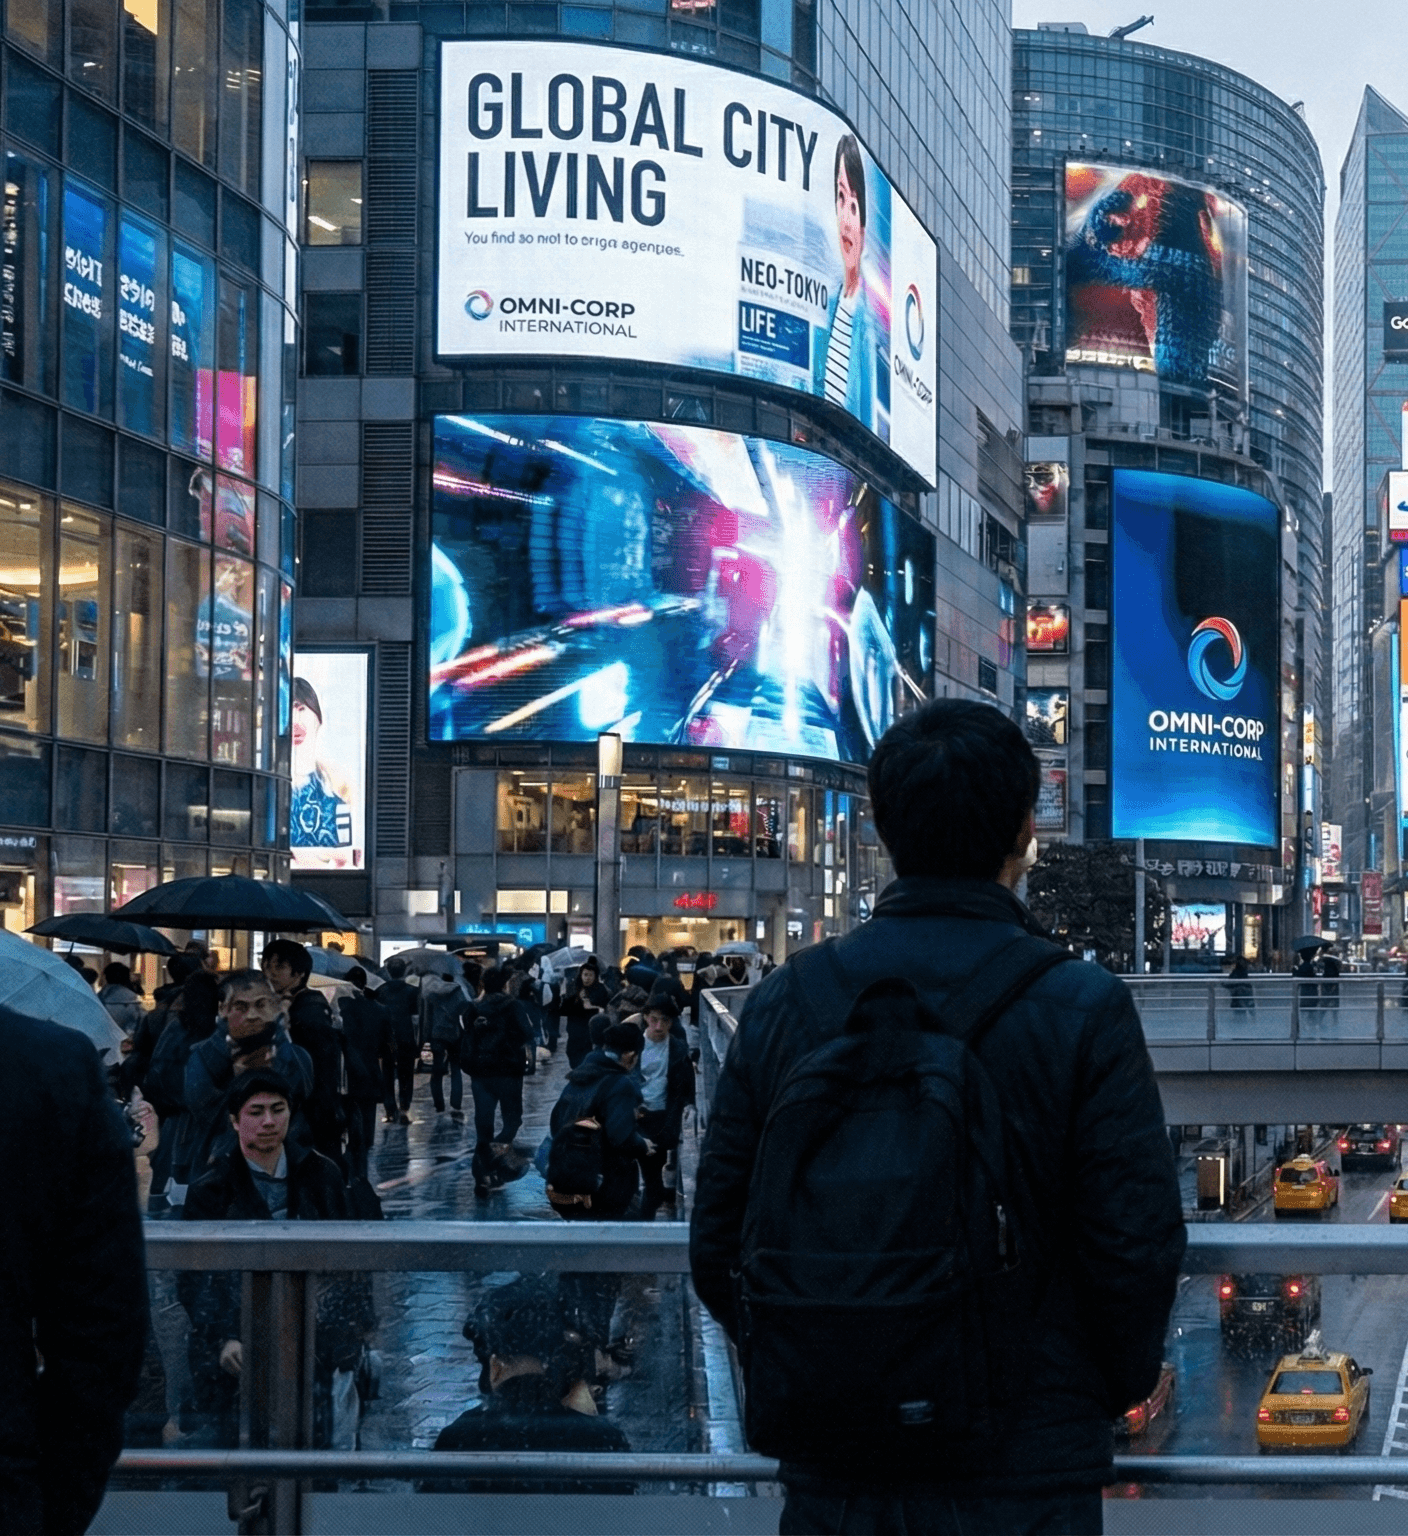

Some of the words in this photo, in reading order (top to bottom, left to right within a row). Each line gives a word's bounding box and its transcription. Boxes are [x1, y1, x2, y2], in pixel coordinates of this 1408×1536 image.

[467, 72, 703, 158] GLOBAL
[723, 101, 818, 192] CITY
[466, 151, 667, 227] LIVING
[464, 231, 488, 244] You
[491, 231, 516, 244] find
[565, 233, 579, 245] to
[741, 256, 828, 311] NEO-TOKYO
[499, 297, 636, 319] OMNI-CORP
[741, 305, 776, 339] LIFE
[499, 319, 638, 338] INTERNATIONAL
[1148, 710, 1265, 741] OMNI-CORP
[1149, 737, 1263, 760] INTERNATIONAL
